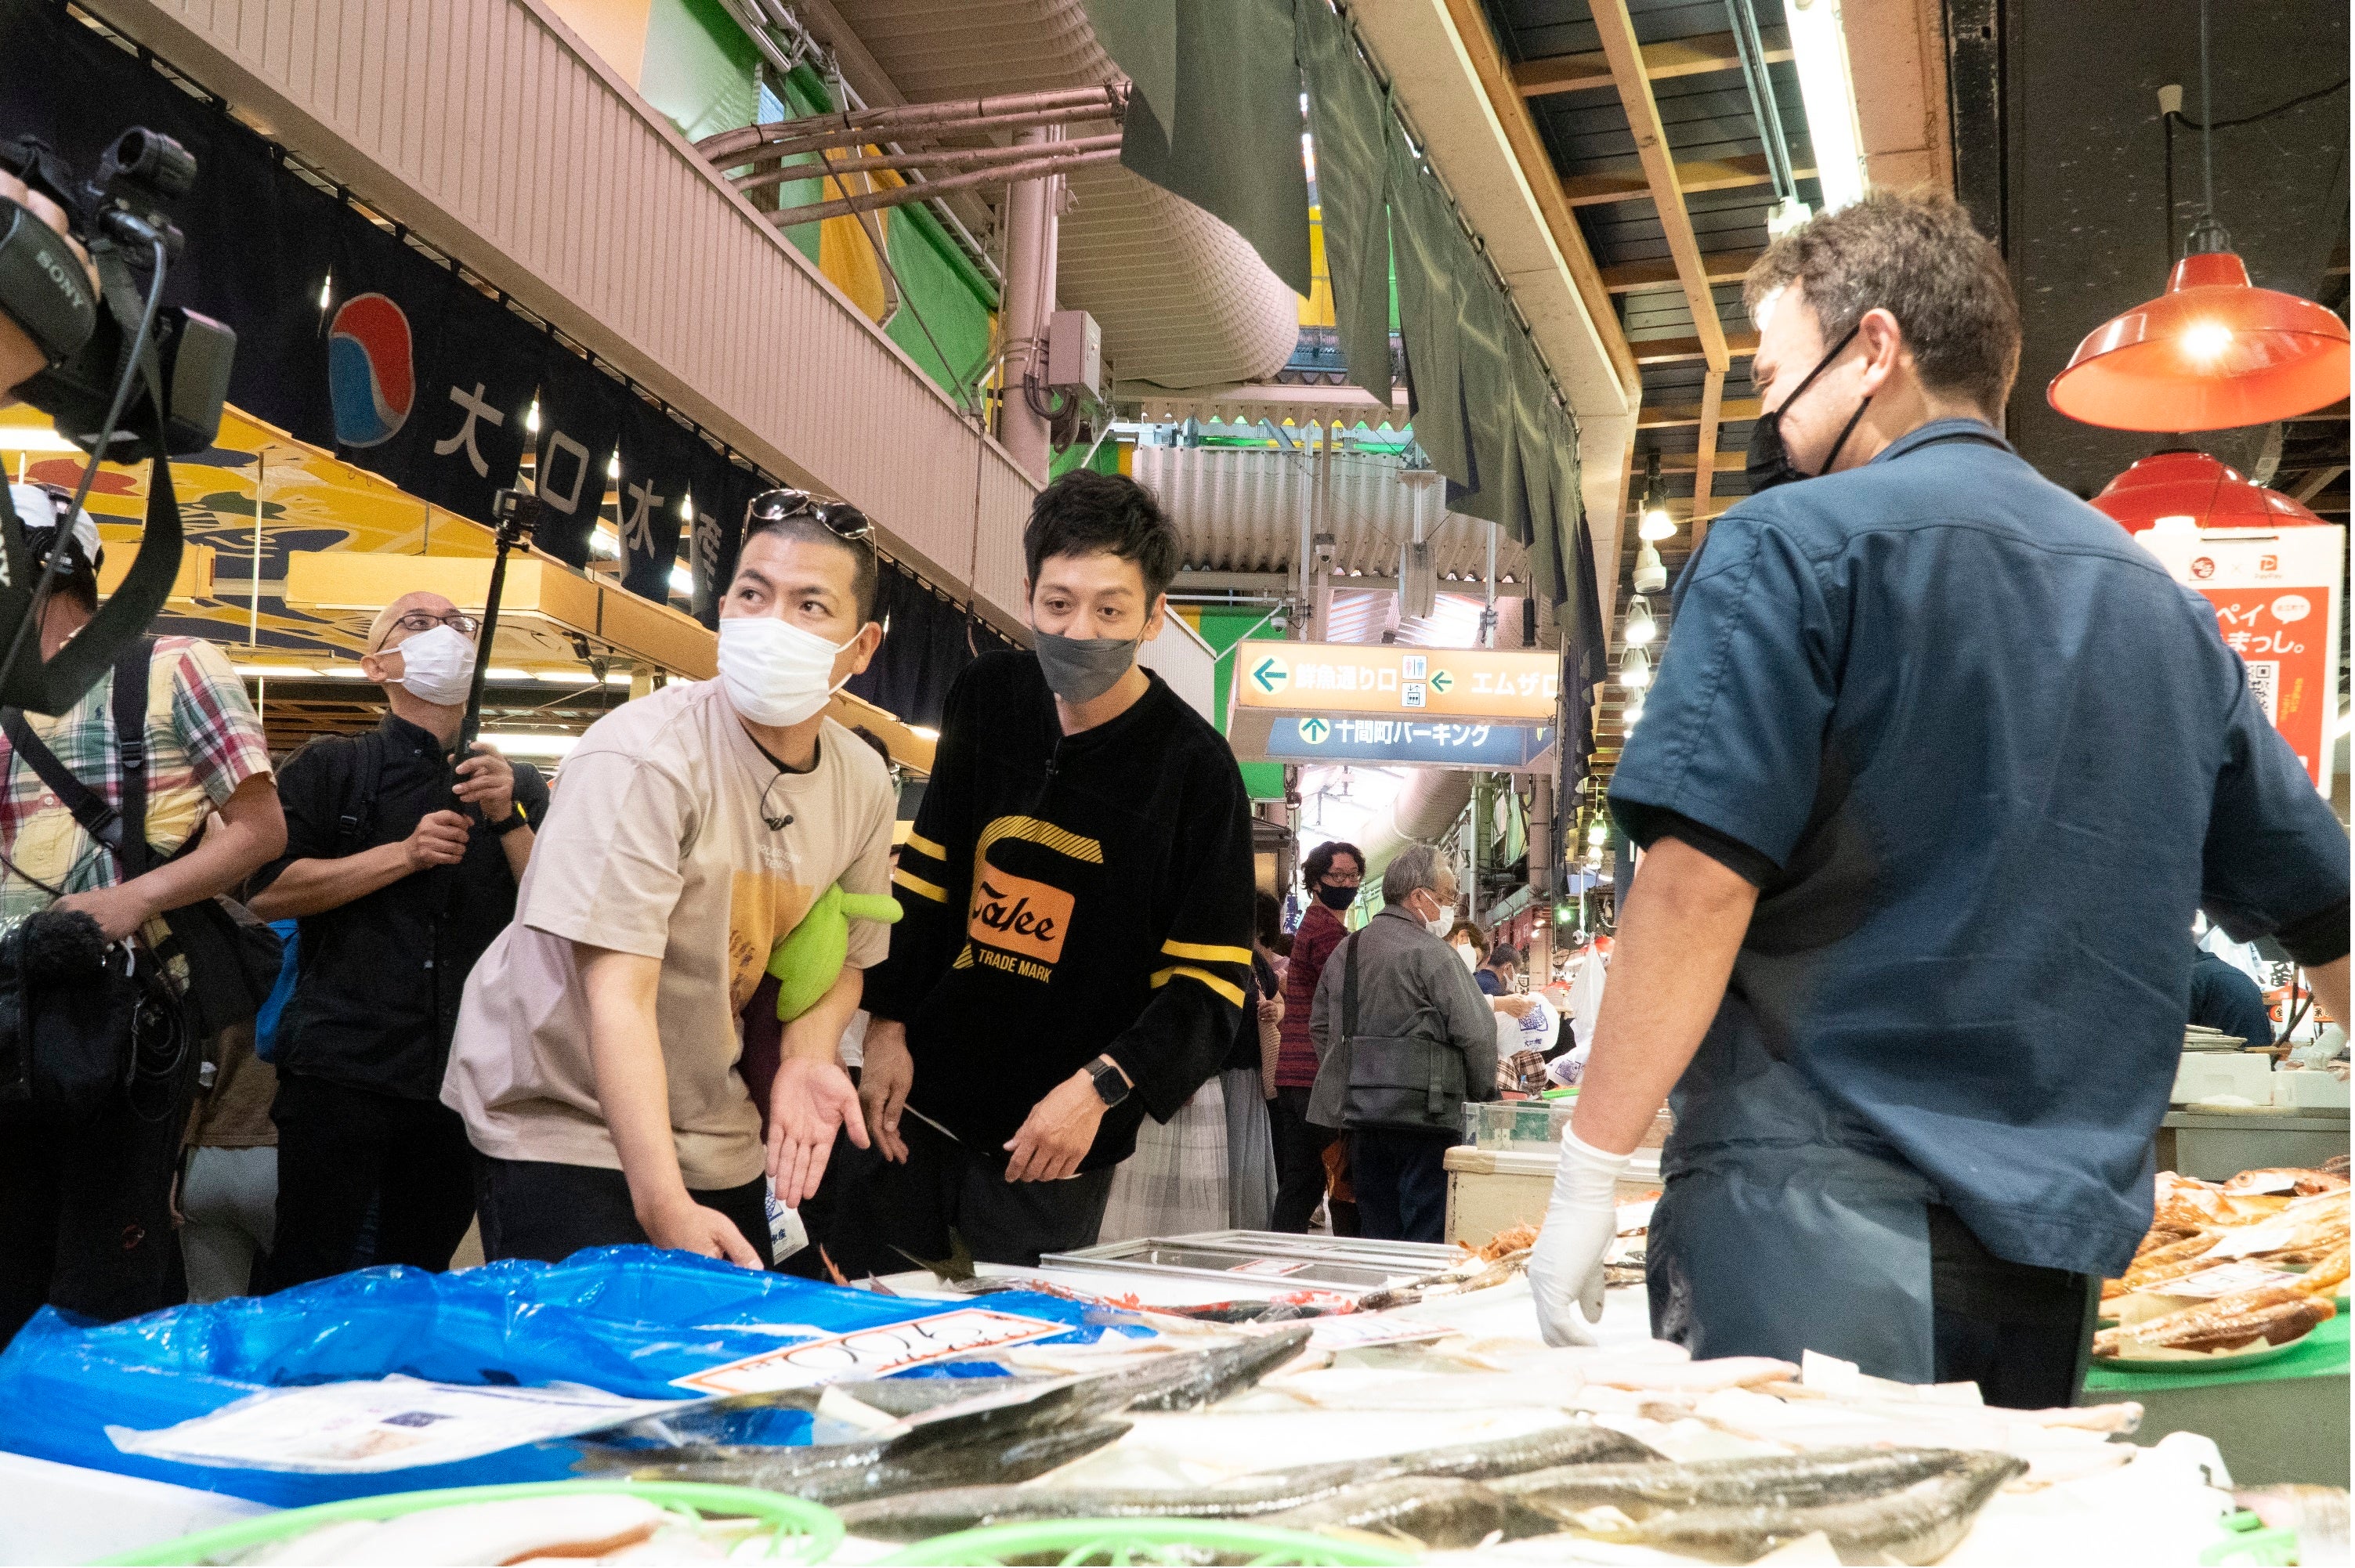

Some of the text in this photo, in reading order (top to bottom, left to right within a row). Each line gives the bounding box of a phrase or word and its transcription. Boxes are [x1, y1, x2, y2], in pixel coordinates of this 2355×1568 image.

[35, 248, 84, 308] SONY
[2216, 603, 2265, 627] ペイ
[1295, 663, 1397, 692] 鮮魚通り口
[1335, 720, 1490, 747] 十間町パーキング
[978, 948, 1052, 984] TRADE MARK
